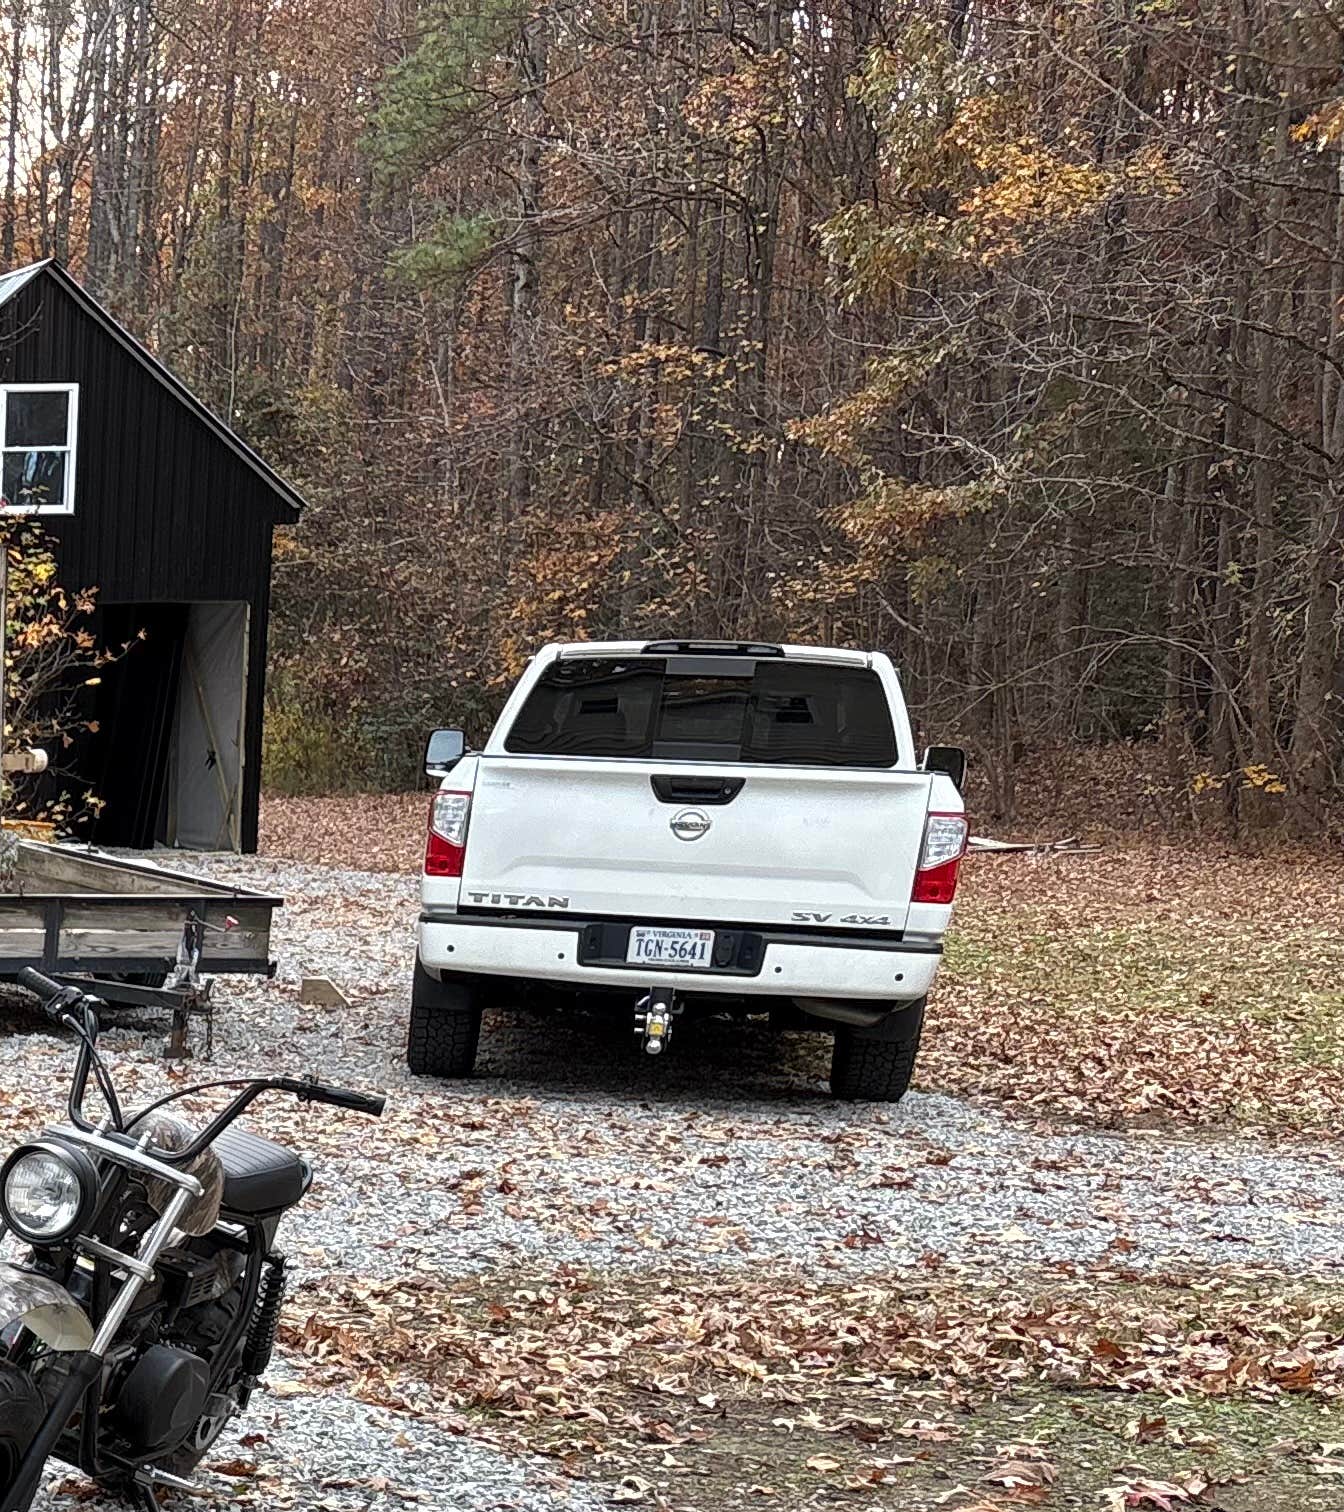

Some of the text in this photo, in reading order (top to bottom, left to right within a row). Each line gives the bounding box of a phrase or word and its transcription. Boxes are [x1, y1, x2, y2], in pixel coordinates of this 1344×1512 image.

[468, 892, 569, 909] TITAN
[791, 912, 833, 923] SV
[653, 930, 693, 939] VIRGINIA
[635, 938, 707, 960] TGN-5641
